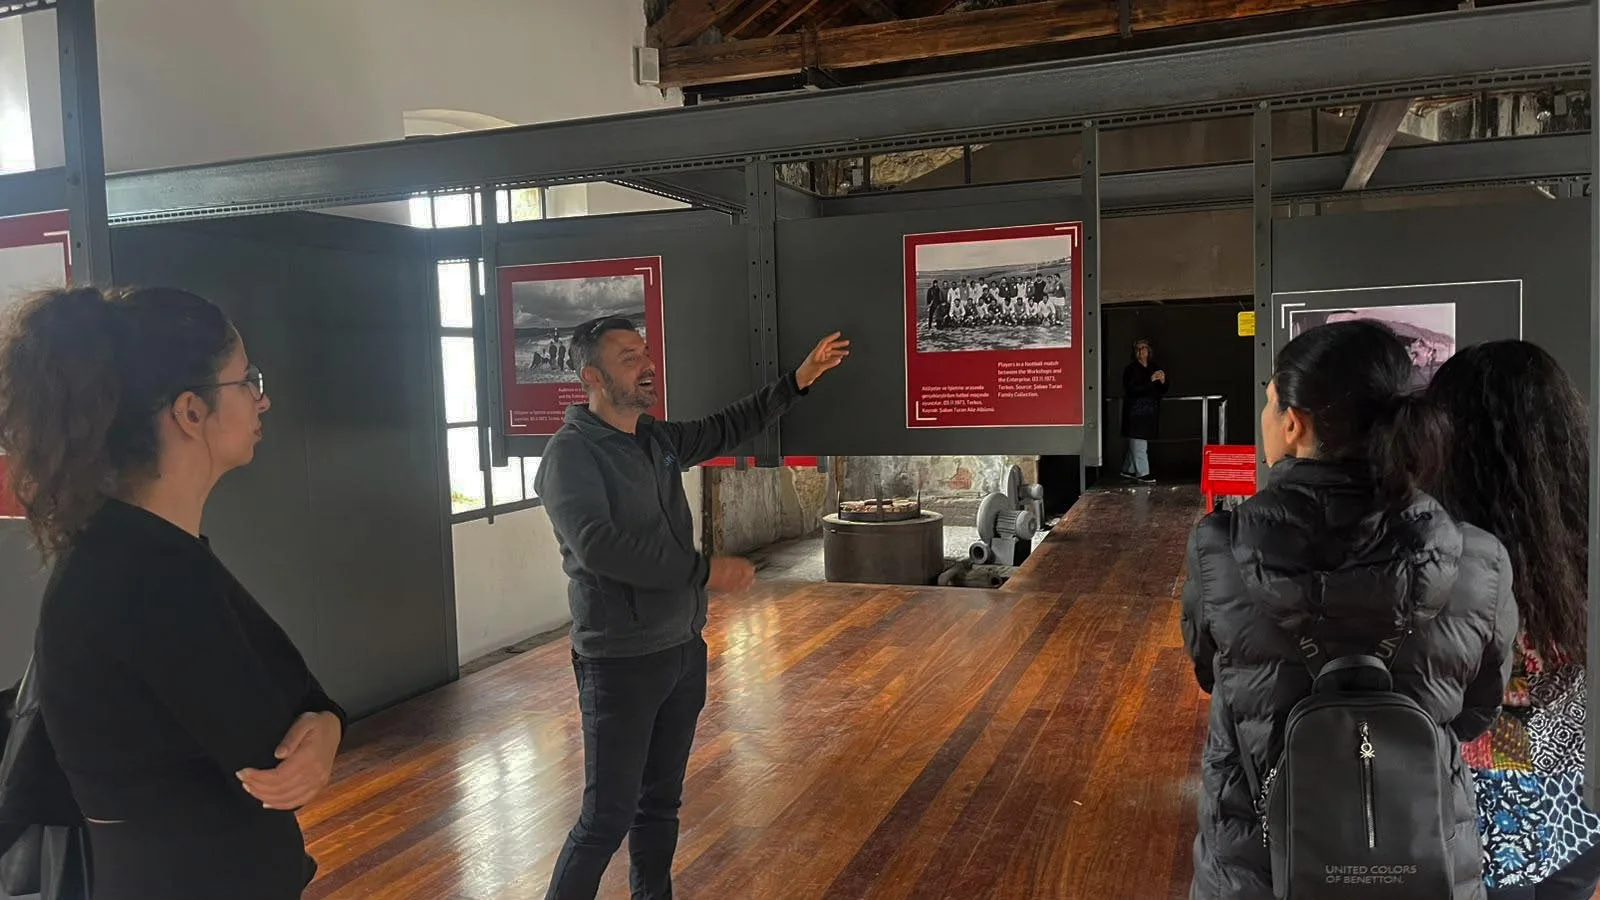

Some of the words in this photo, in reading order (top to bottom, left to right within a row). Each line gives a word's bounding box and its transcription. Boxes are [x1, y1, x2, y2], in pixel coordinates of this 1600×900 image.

[1325, 865, 1368, 874] UNITED
[1370, 864, 1417, 874] COLORS
[1326, 875, 1341, 884] OF
